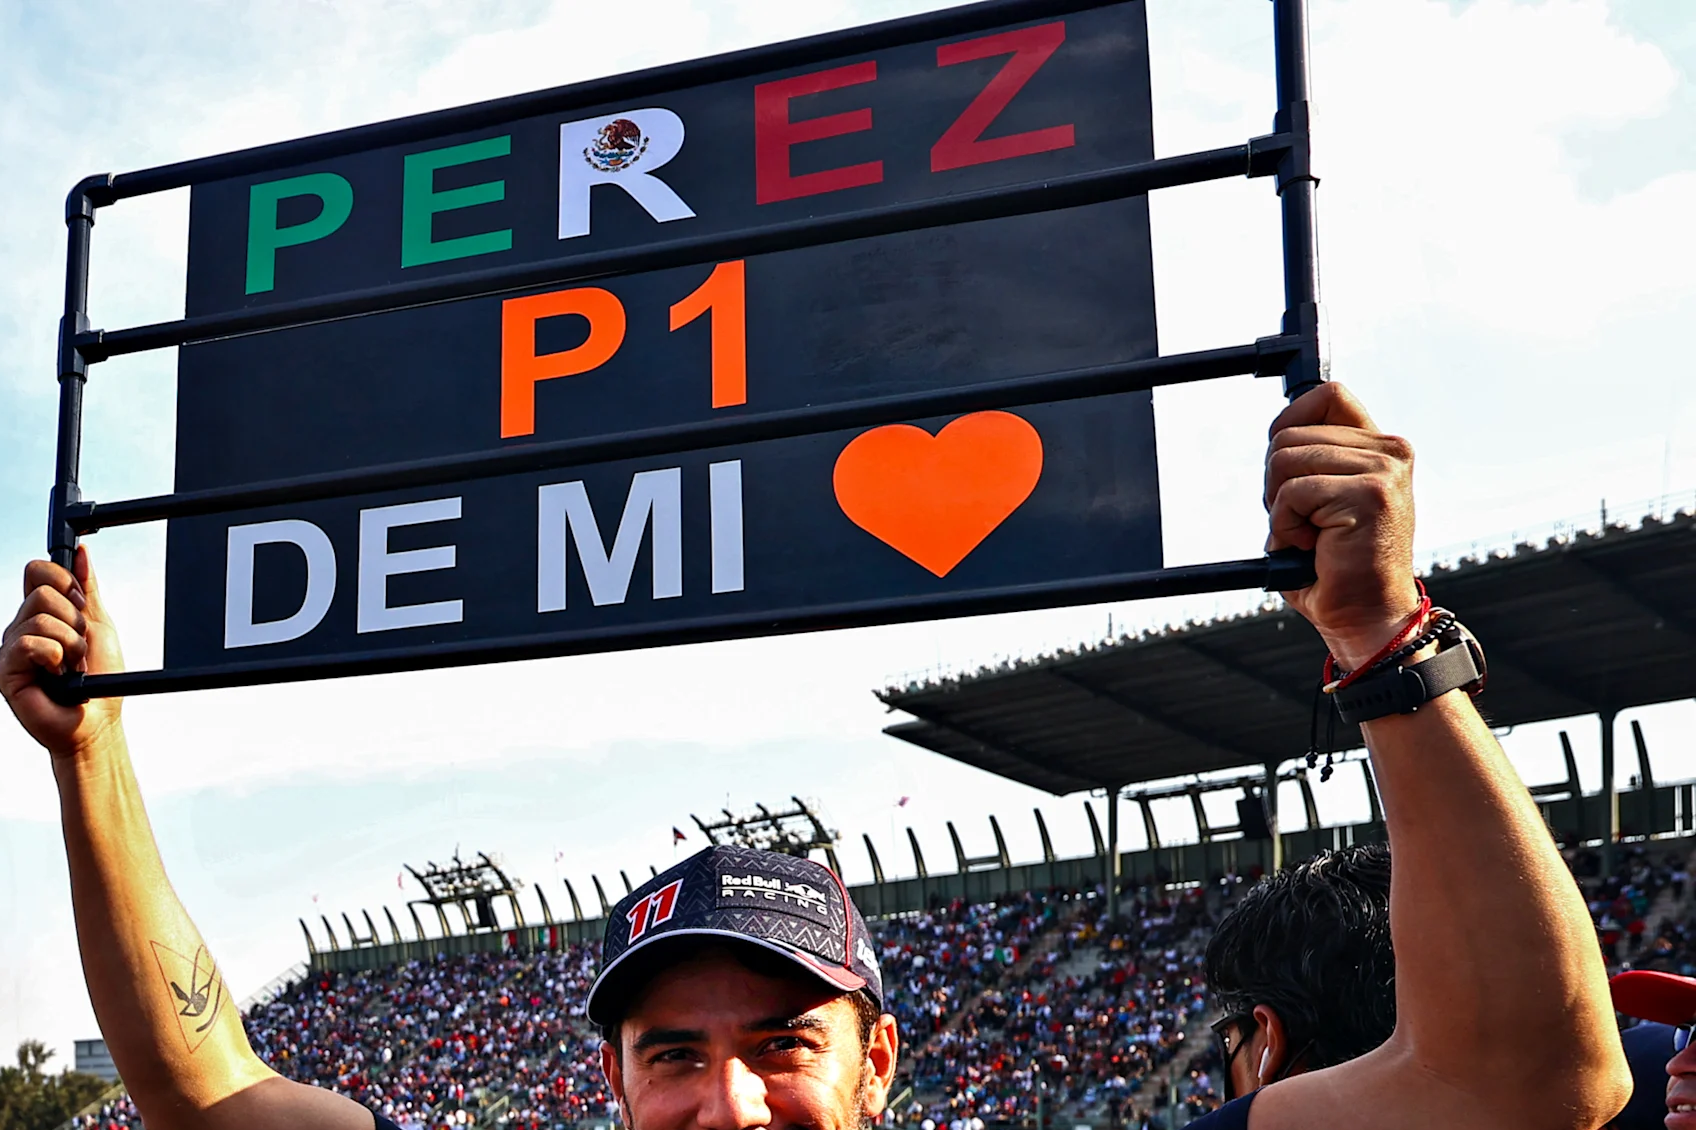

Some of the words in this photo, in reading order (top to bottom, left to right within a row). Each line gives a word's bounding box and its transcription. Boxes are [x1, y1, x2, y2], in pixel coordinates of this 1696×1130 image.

[246, 21, 1076, 296] PEREZ
[501, 260, 746, 438] P1
[225, 497, 464, 649] DE
[538, 460, 745, 613] MI
[626, 878, 684, 945] 11
[722, 874, 752, 887] Red
[752, 876, 782, 891] Bull
[722, 889, 828, 915] RACING
